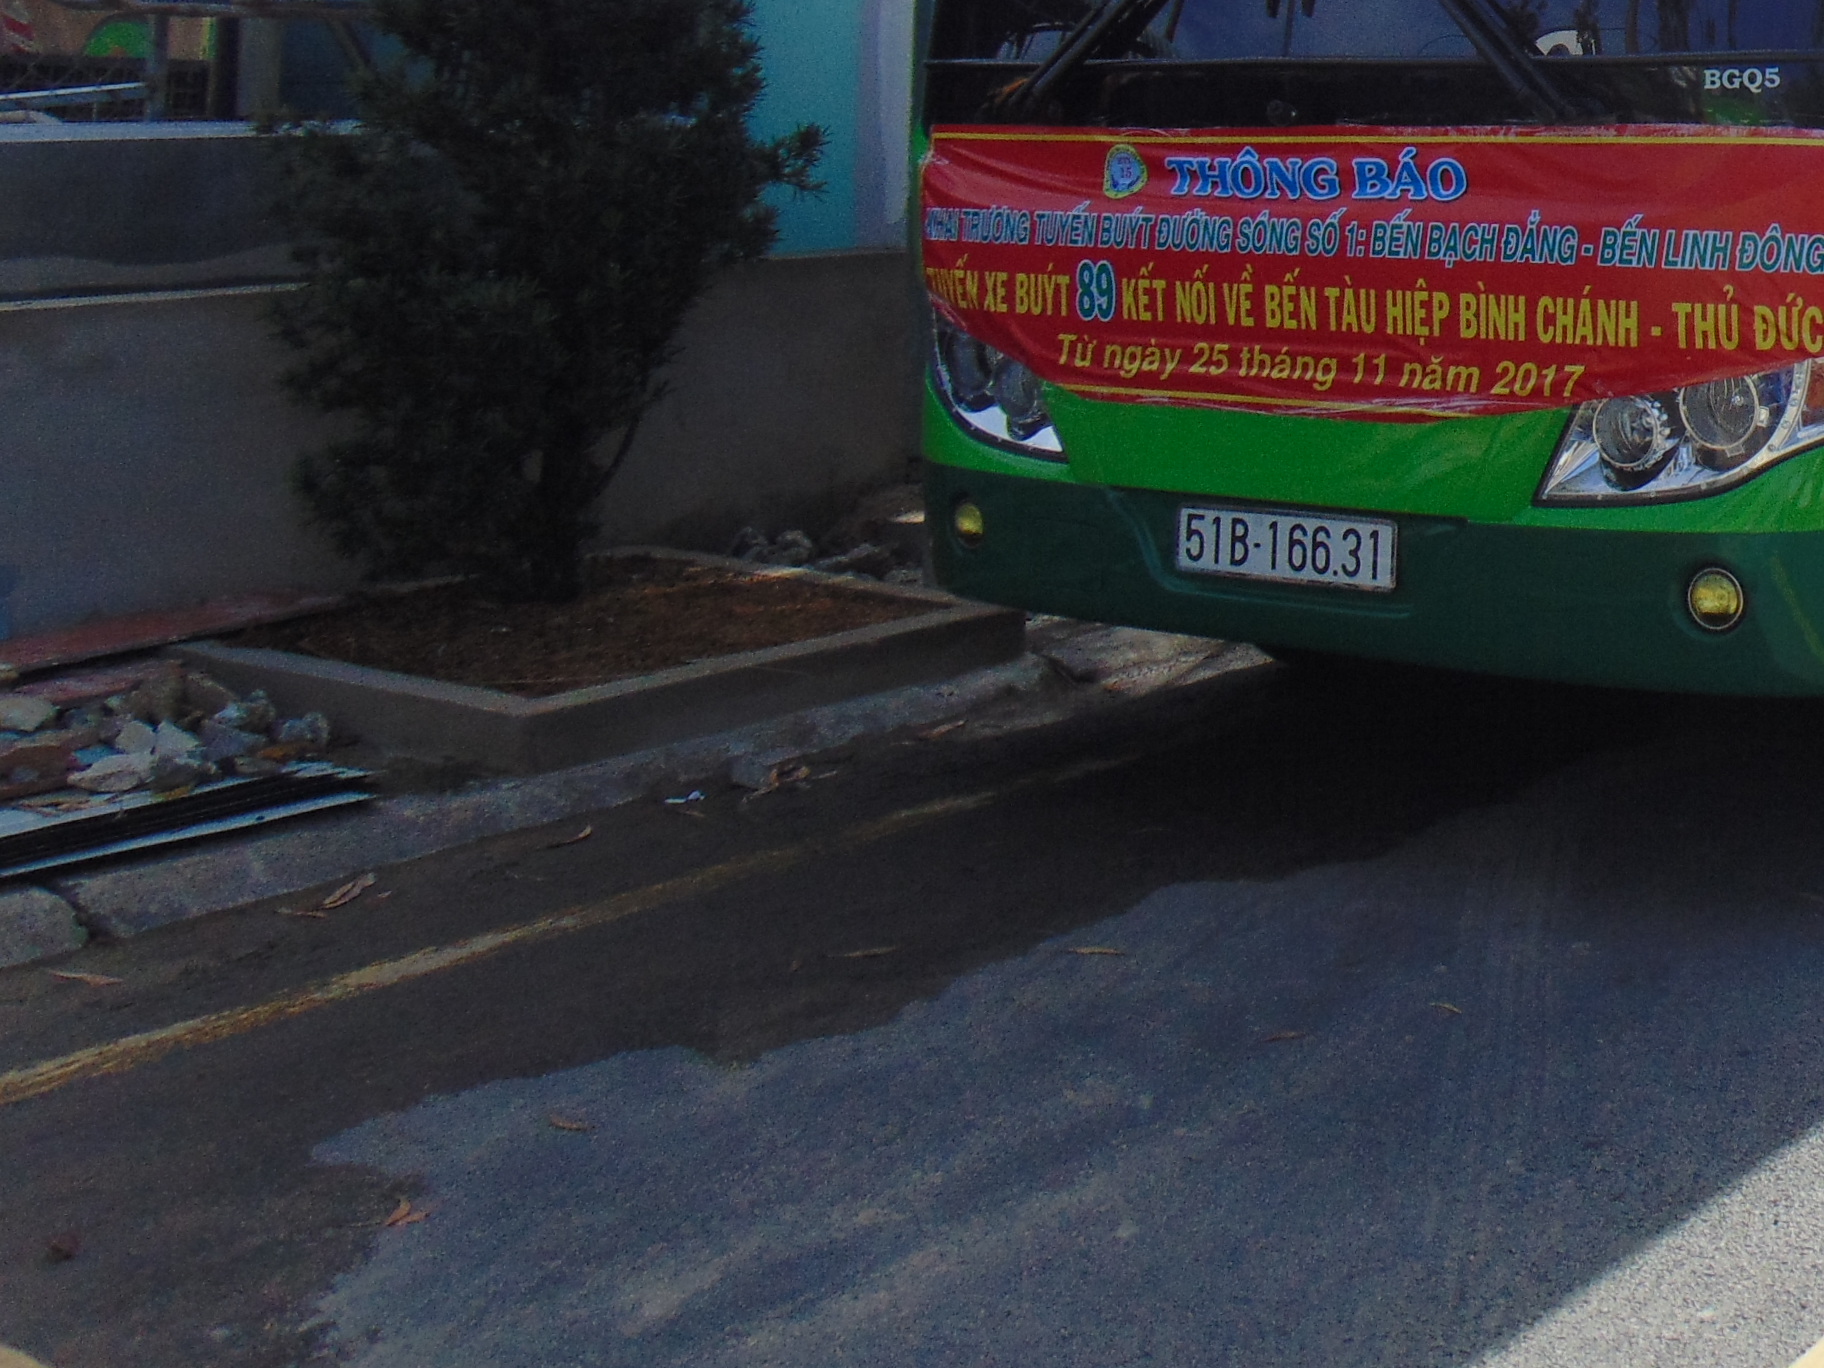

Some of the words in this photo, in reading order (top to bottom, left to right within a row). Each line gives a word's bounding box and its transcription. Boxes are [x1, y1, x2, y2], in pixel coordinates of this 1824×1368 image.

[1703, 66, 1782, 93] BGQ5
[1165, 145, 1339, 200] THÔNG
[1351, 145, 1468, 201] BÁO
[1034, 200, 1098, 249] TUYẾN
[1098, 205, 1156, 250] BUÝT
[1155, 208, 1232, 253] ĐƯỜNG
[1236, 209, 1301, 256] SÔNG
[1304, 206, 1347, 259] SỐ
[1369, 208, 1421, 260] BẾN
[1424, 221, 1500, 269] BẠCH
[1596, 214, 1661, 269] BẾN
[1661, 229, 1734, 271] LINH
[983, 272, 1009, 314] XE
[1014, 263, 1071, 317] BUÝT
[1075, 258, 1117, 323] 89
[1121, 261, 1168, 322] KẾT
[1174, 263, 1217, 327] NỐI
[1222, 262, 1256, 328] VỀ
[1264, 266, 1318, 331] BẾN
[1324, 274, 1378, 335] TÀU
[1386, 277, 1451, 346] HIỆP
[1458, 281, 1526, 343] BÌNH
[1535, 284, 1640, 349] CHÁNH
[1671, 284, 1740, 352] THỦ
[1752, 291, 1824, 354] ĐỨC
[1056, 333, 1099, 368] Từ
[1102, 343, 1184, 381] ngày
[1190, 342, 1230, 375] 25
[1239, 345, 1339, 391] tháng
[1351, 352, 1388, 383] 11
[1398, 355, 1482, 394] năm
[1490, 359, 1586, 399] 2017
[1184, 512, 1381, 581] 51B-166.31
